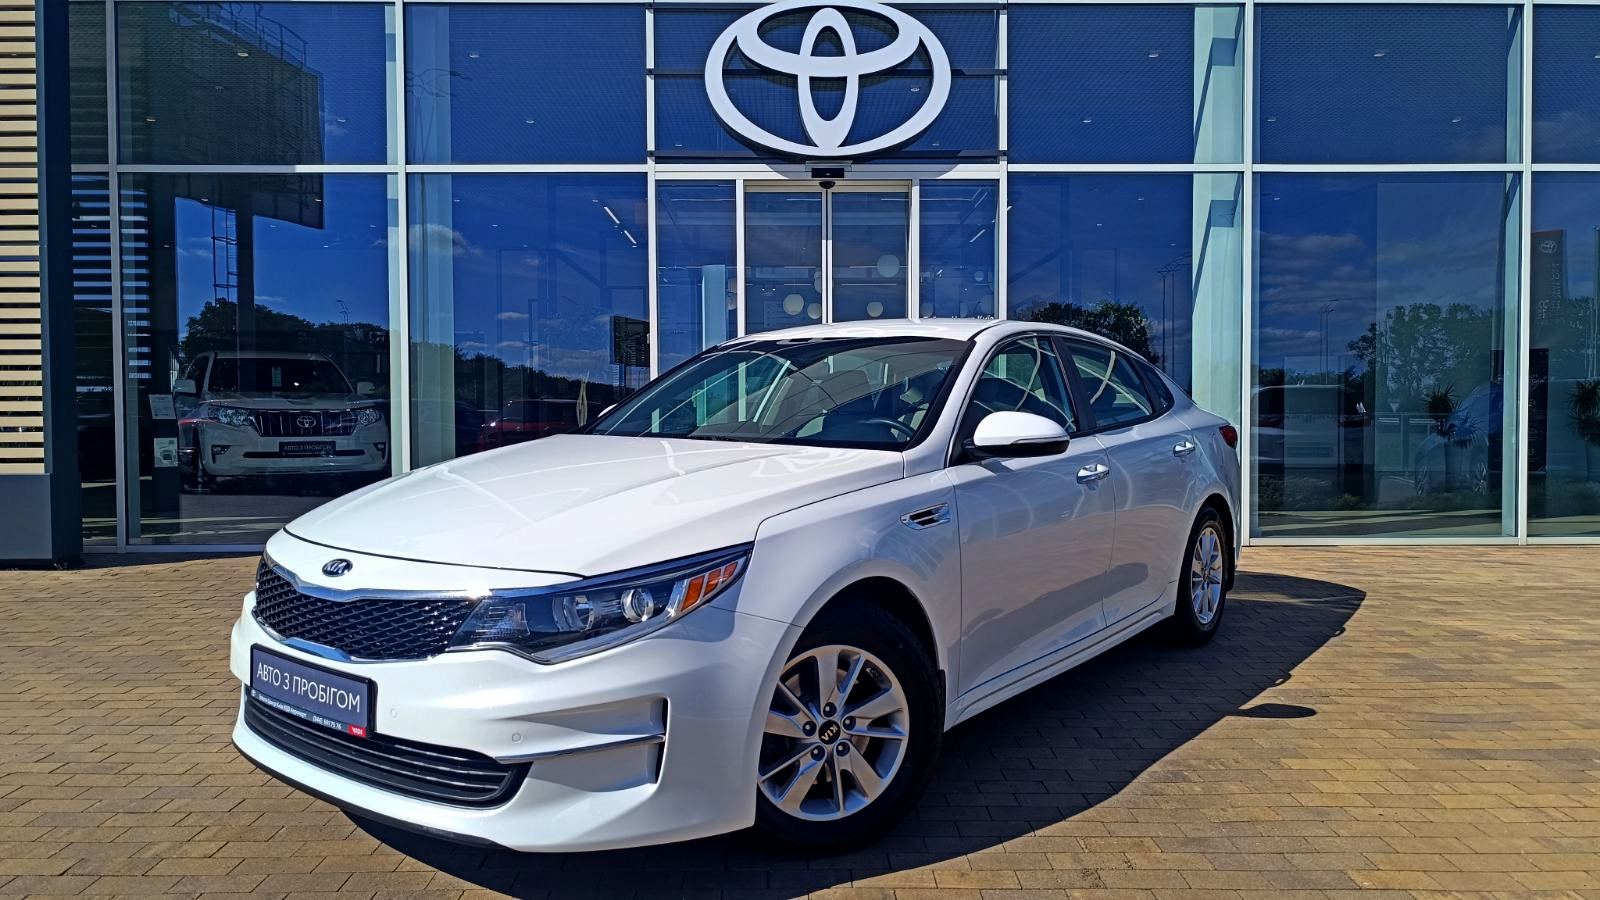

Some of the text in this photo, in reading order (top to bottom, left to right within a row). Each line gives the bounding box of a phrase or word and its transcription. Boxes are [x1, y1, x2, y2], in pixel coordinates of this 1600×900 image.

[256, 662, 281, 686] АВТО
[283, 673, 290, 690] З
[292, 676, 360, 712] ПРОБІГОМ
